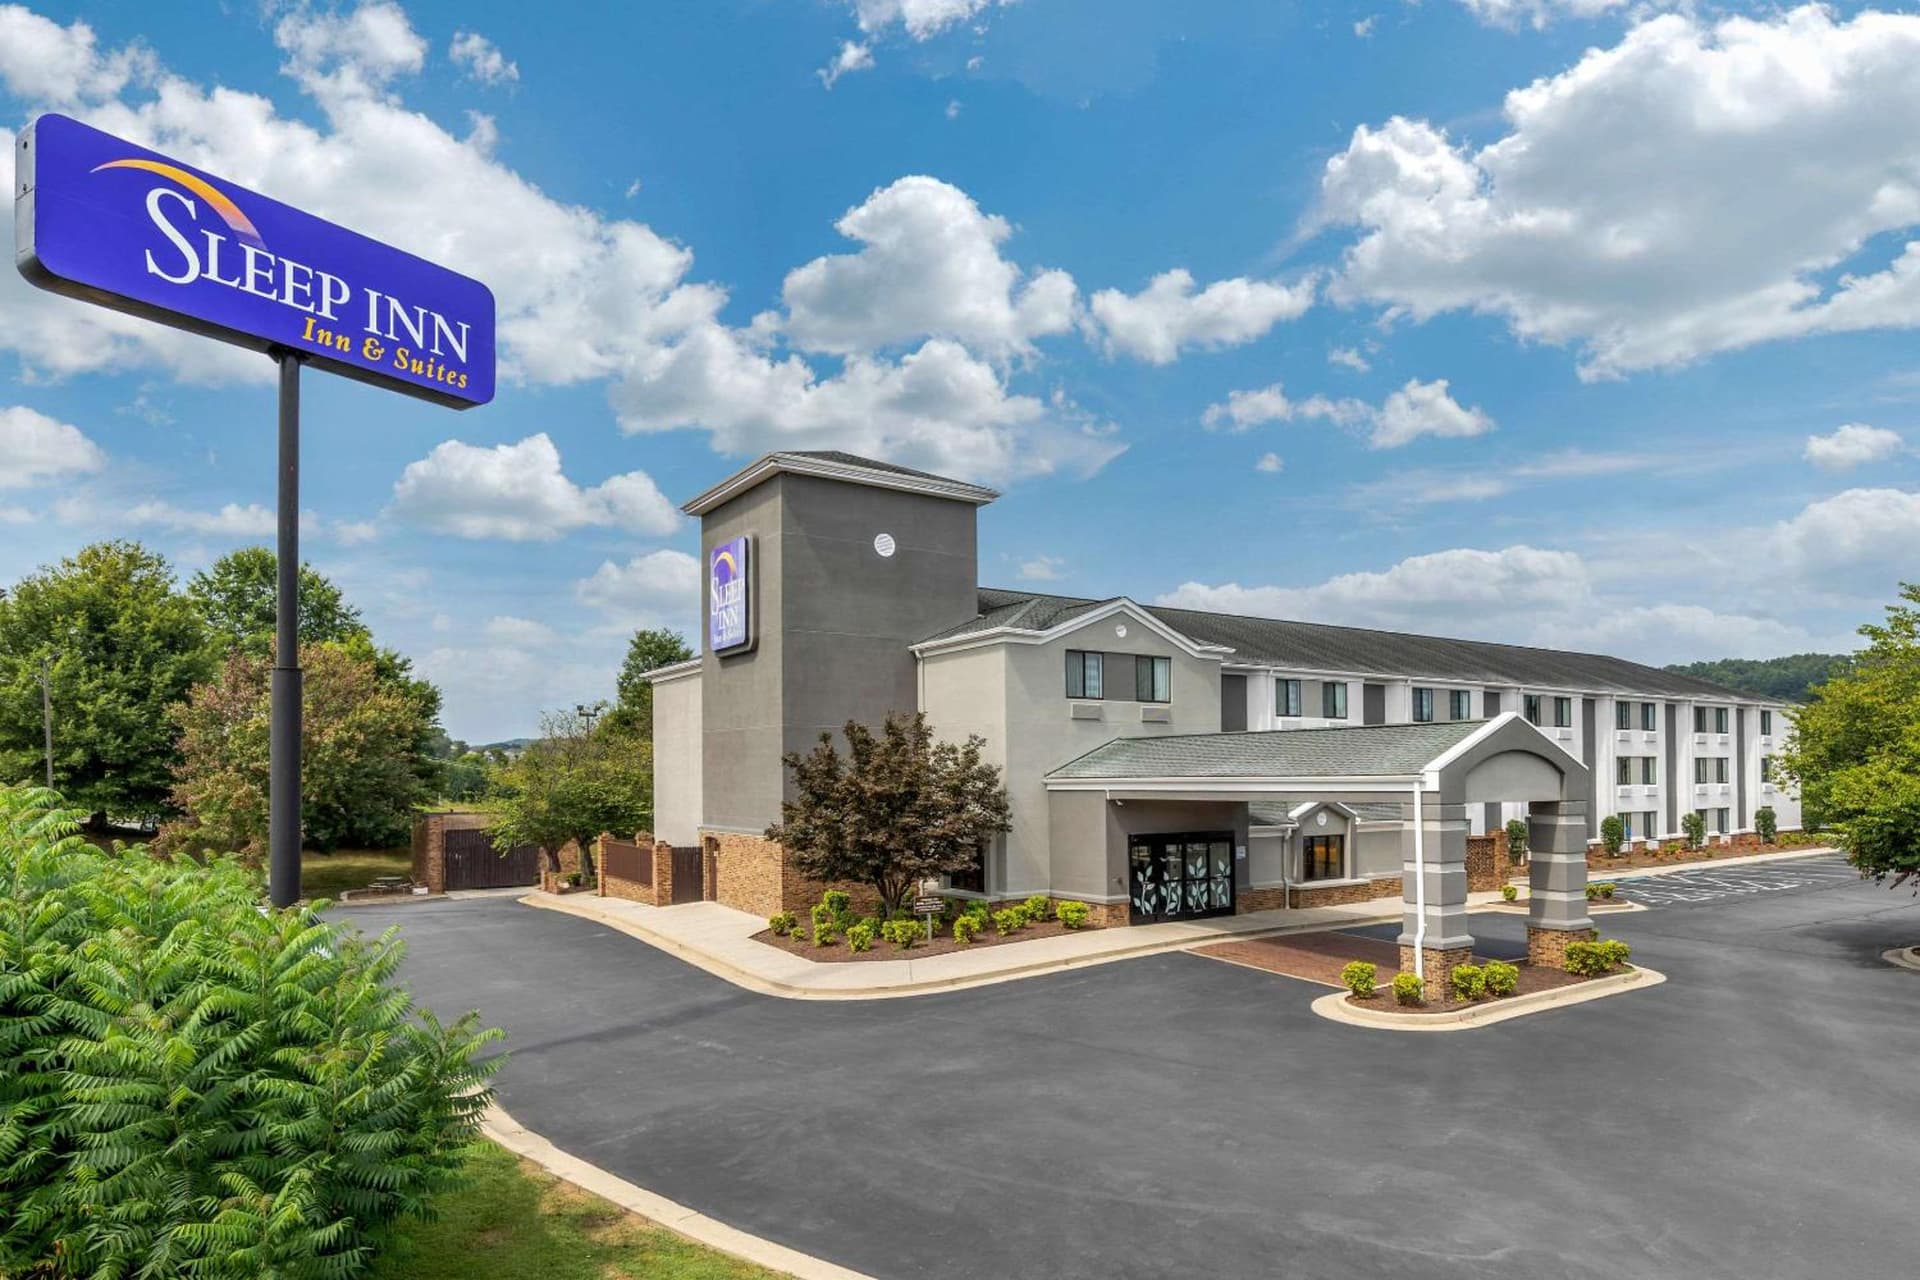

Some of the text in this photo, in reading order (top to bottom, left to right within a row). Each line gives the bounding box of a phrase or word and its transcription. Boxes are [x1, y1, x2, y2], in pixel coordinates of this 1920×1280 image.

[145, 187, 471, 364] SLEEP INN
[302, 316, 469, 389] Inn & Suites
